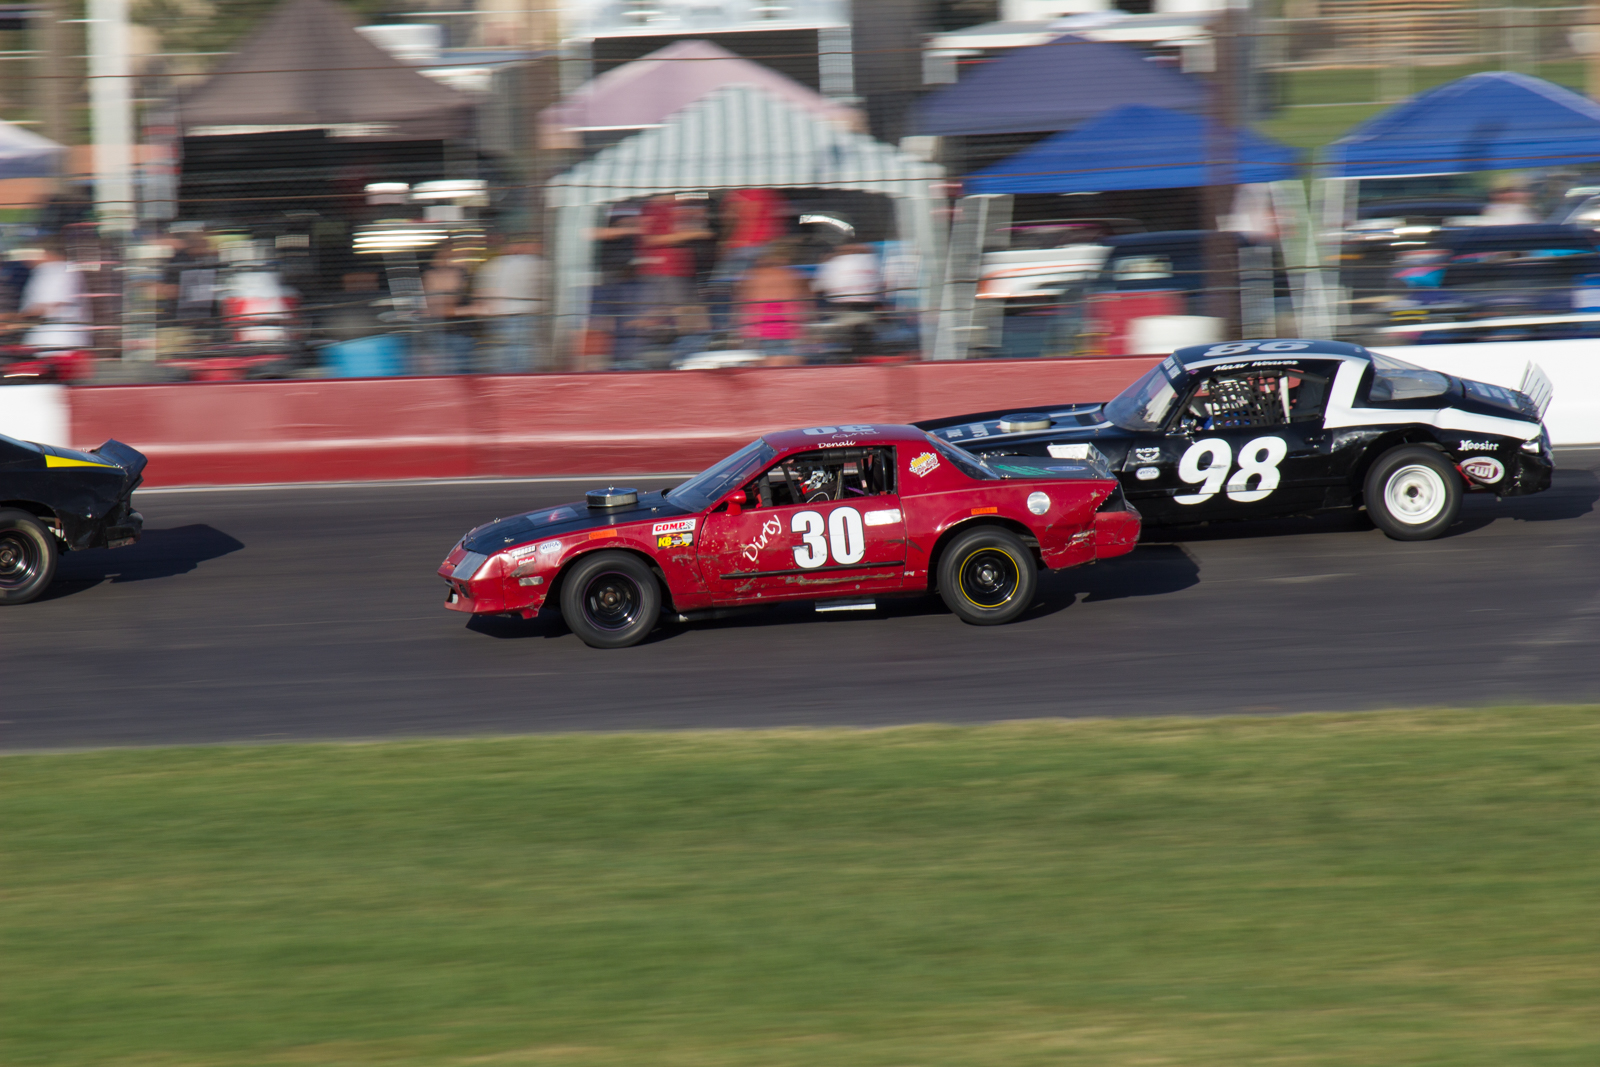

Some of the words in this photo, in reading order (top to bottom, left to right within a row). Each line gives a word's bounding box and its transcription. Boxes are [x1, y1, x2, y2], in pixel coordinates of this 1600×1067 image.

[817, 439, 856, 449] Denali
[1456, 439, 1500, 451] Hoosier
[1173, 436, 1287, 505] 98
[655, 521, 686, 532] COMP
[658, 536, 672, 548] KB
[742, 514, 782, 562] Dirty
[790, 506, 865, 569] 30
